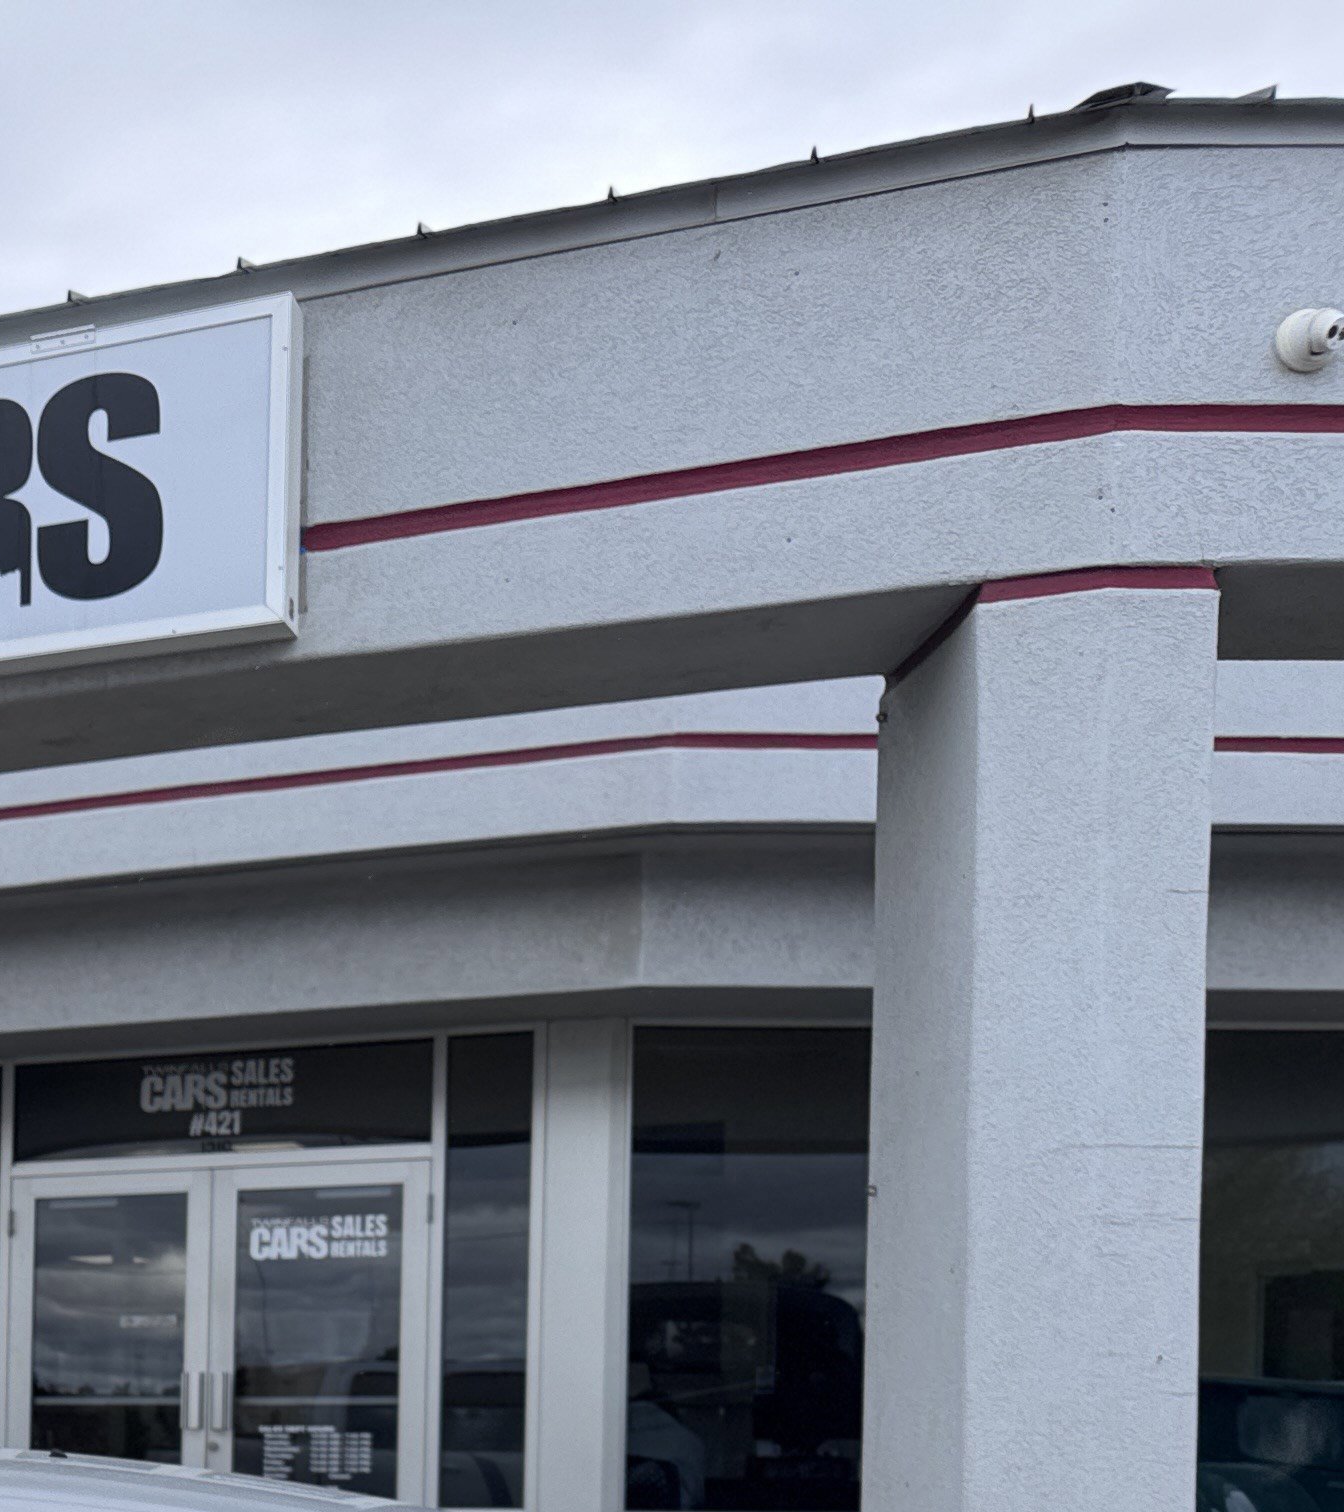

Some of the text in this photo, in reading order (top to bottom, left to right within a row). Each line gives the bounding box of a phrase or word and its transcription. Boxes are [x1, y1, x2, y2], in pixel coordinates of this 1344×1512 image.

[230, 1058, 294, 1085] SALES
[140, 1070, 227, 1113] CARS
[230, 1086, 293, 1108] RENTALS
[189, 1109, 241, 1136] #421
[331, 1214, 388, 1238] SALES
[250, 1225, 328, 1261] CARS
[330, 1239, 388, 1258] RENTALS
